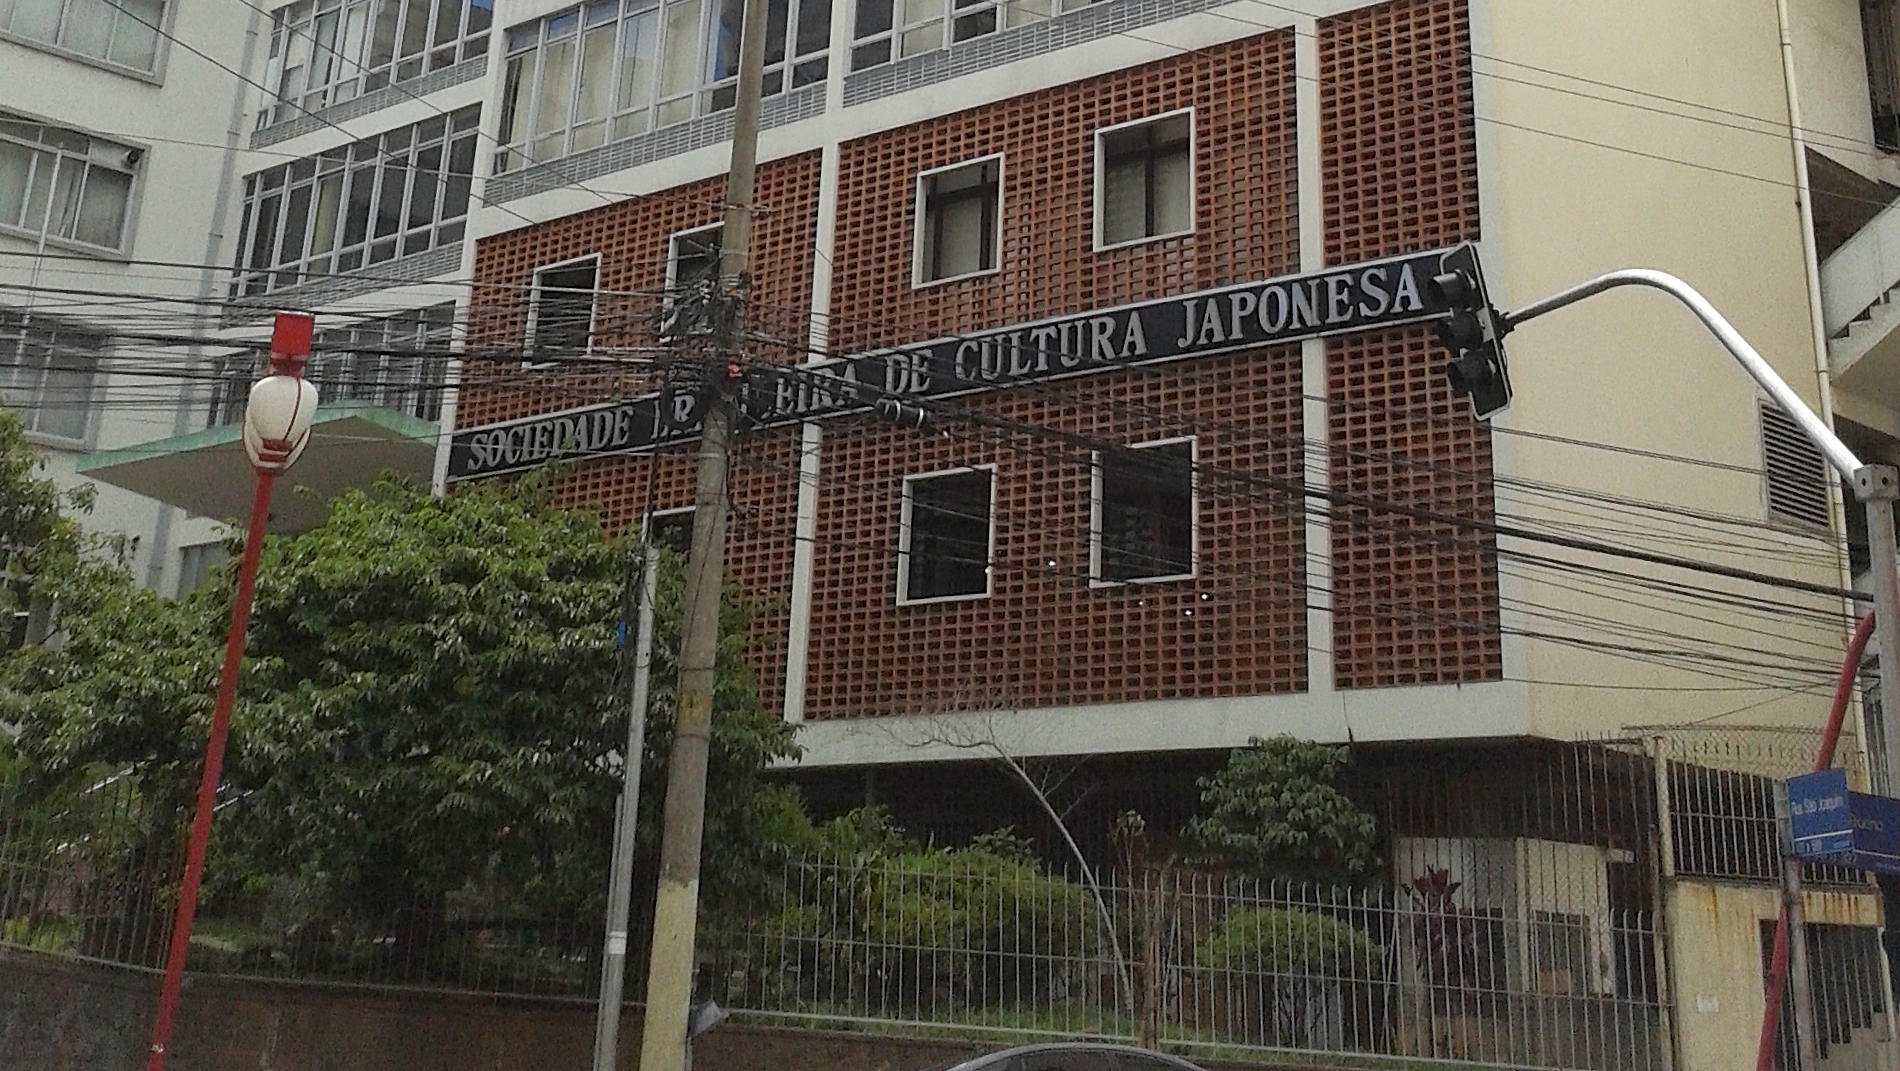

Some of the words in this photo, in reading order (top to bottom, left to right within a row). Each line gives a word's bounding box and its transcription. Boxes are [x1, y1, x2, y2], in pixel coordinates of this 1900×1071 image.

[467, 405, 636, 471] SOCIEDADE
[884, 349, 934, 395] DE
[954, 310, 1148, 381] CULTURA
[1177, 262, 1424, 348] JAPONESA
